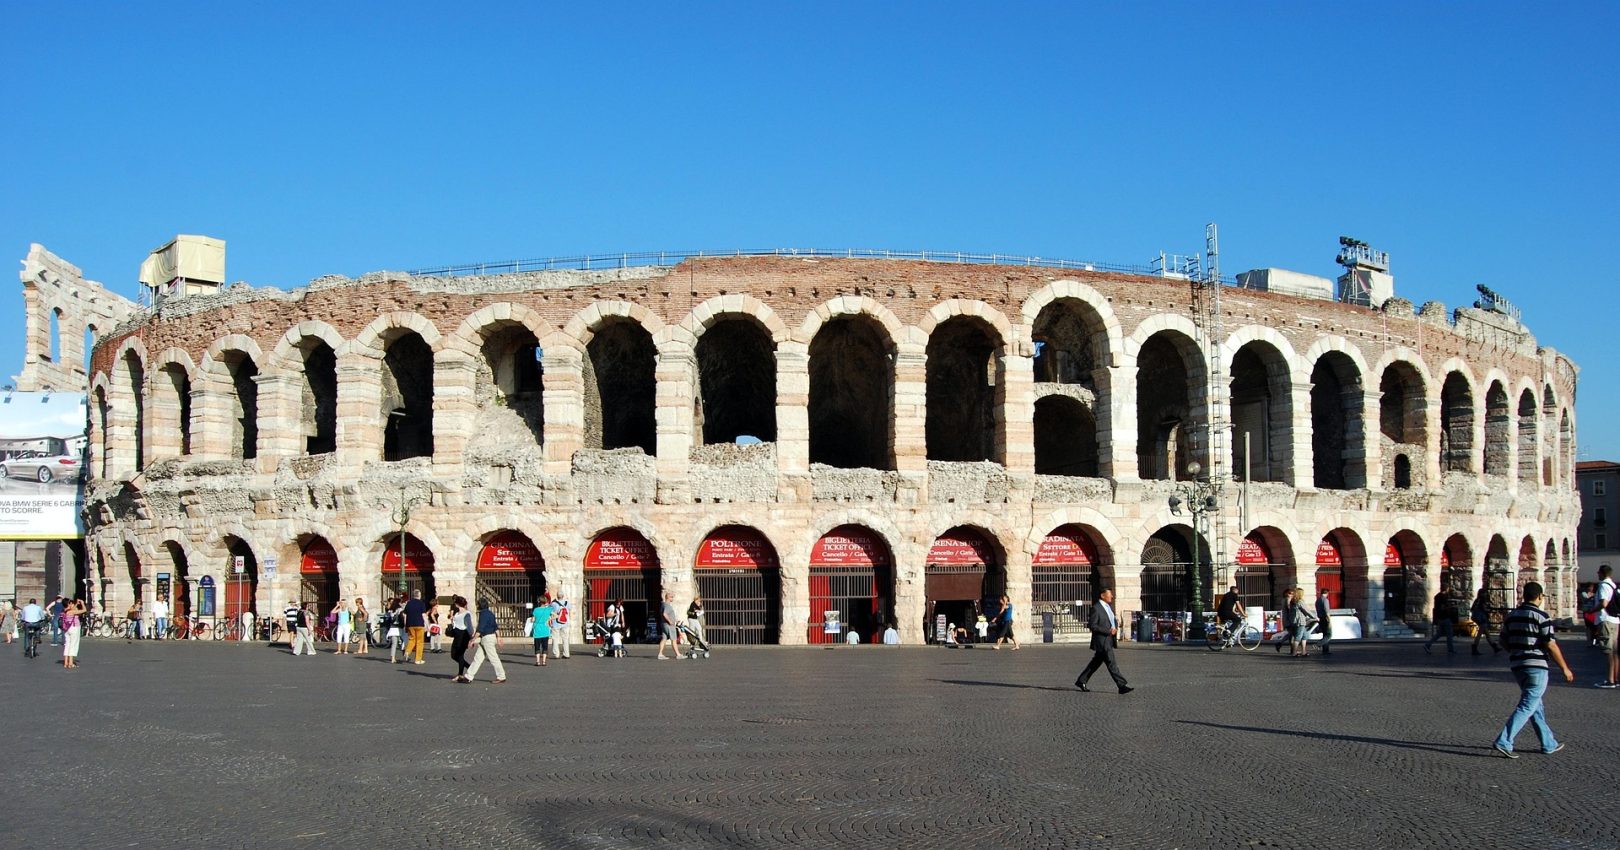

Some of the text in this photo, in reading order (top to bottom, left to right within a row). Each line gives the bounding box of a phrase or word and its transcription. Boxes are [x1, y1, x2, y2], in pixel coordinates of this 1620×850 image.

[710, 540, 762, 548] POLTRONE
[824, 536, 871, 544] BIGLIETTERIA
[624, 547, 650, 555] OFFICE
[823, 543, 872, 551] TICKET OFFICE
